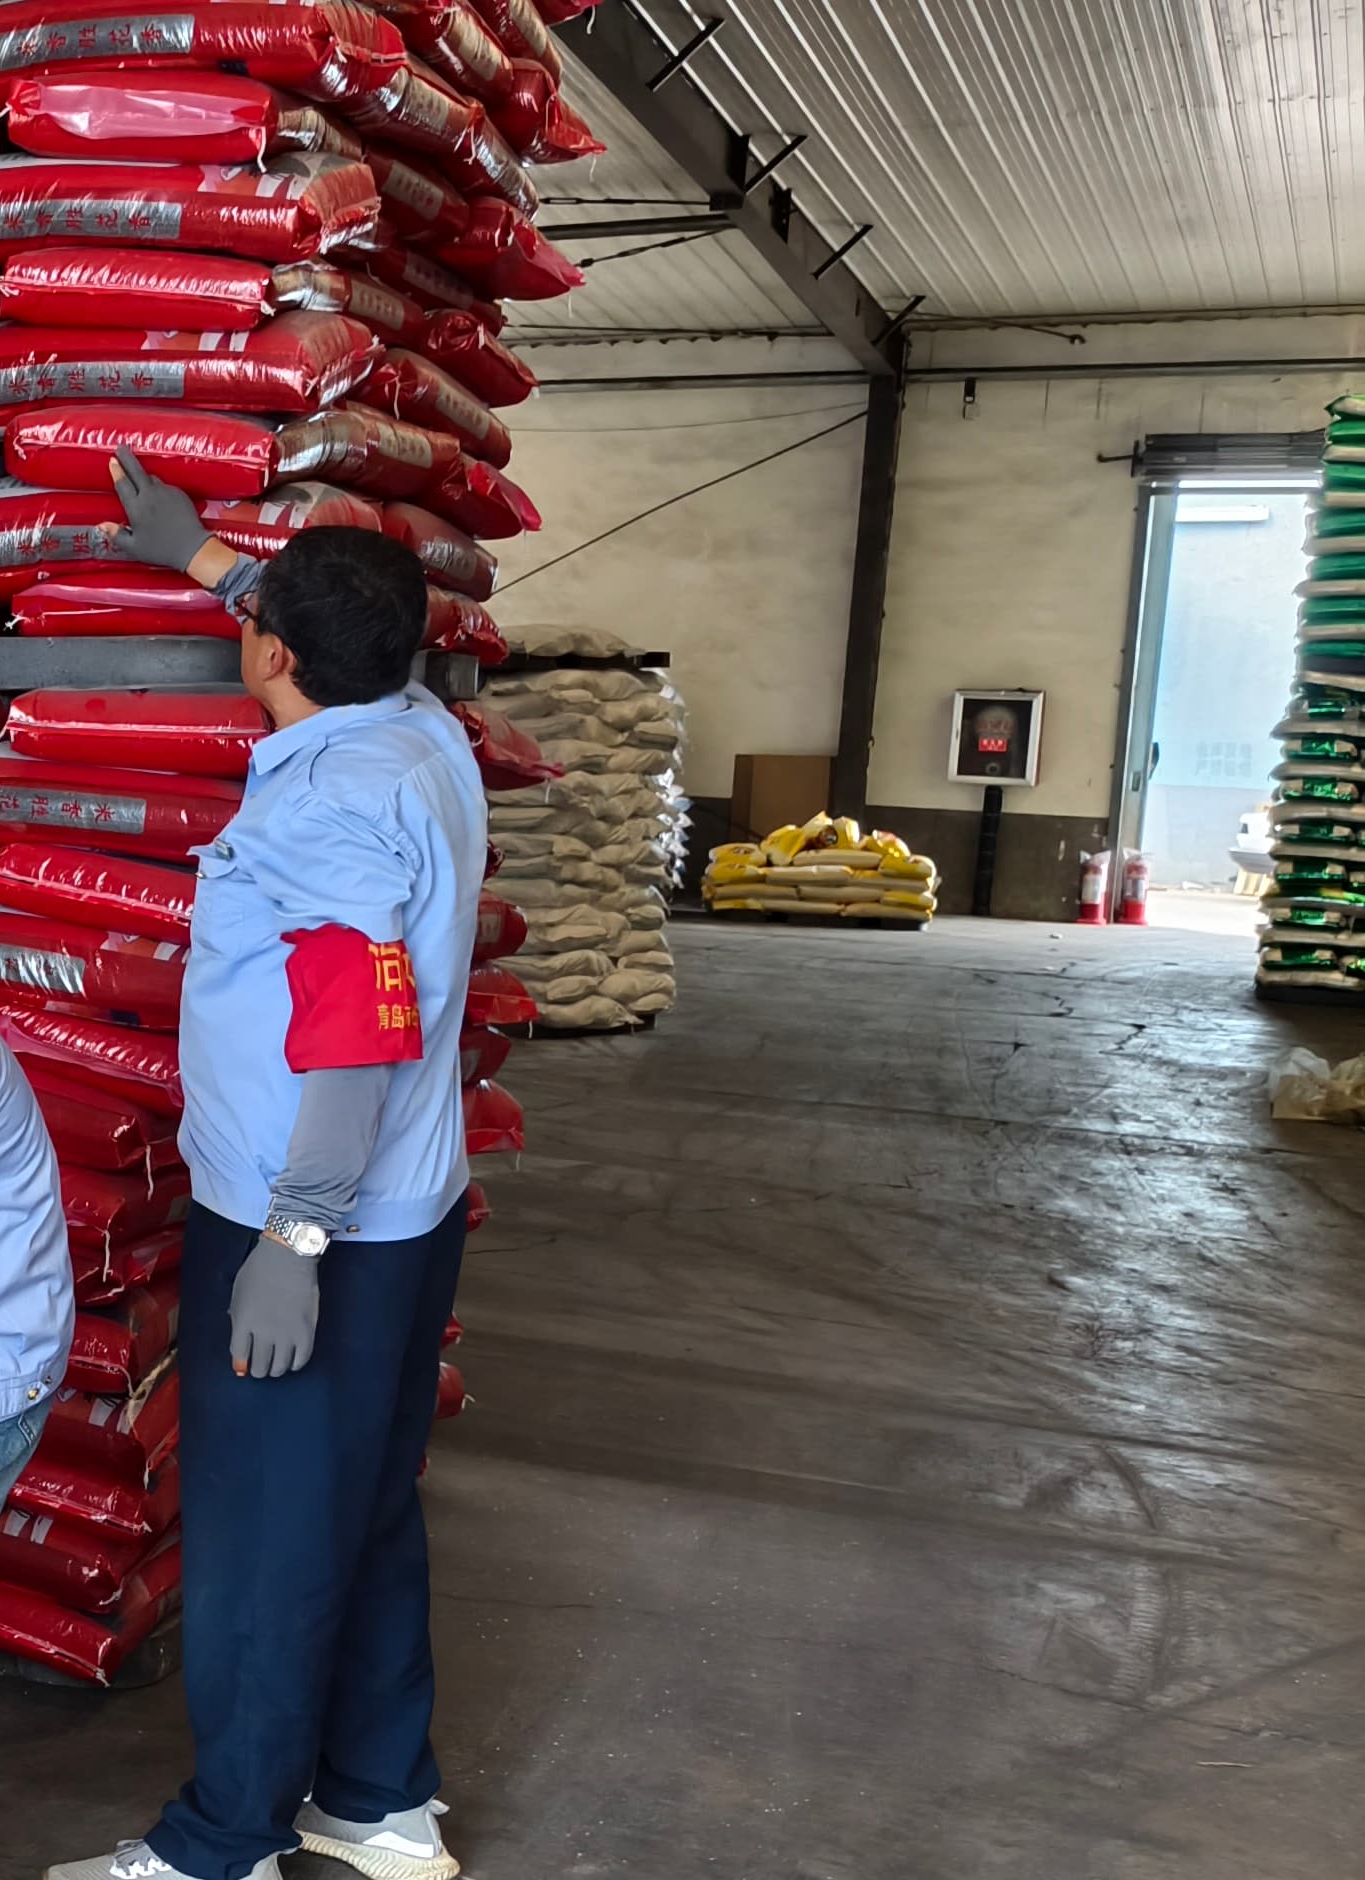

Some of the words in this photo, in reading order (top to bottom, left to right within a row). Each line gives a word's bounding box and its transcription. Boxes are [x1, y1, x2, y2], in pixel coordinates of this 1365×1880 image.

[9, 371, 155, 403] 米香胜花香
